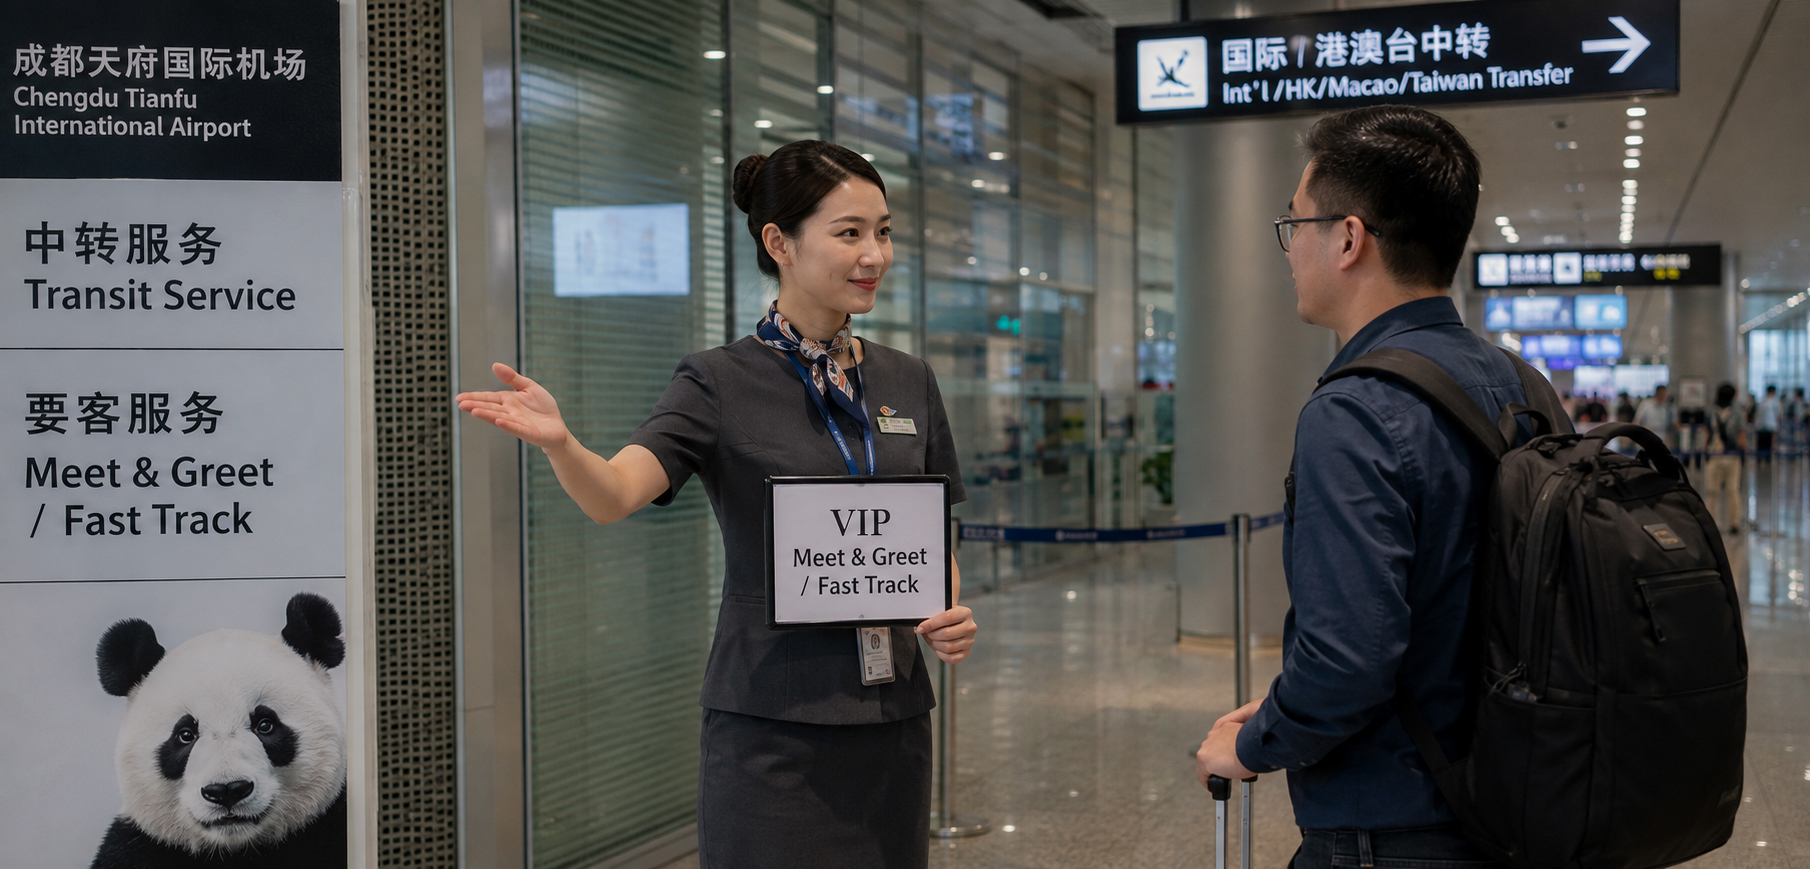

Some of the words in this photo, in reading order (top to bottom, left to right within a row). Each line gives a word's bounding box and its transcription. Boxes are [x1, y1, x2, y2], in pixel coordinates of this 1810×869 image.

[1314, 22, 1490, 67] 港澳台中转
[12, 43, 305, 80] 成都天府国际机场
[1486, 63, 1573, 88] Transfer
[13, 86, 118, 112] Chengdu
[124, 88, 196, 108] Tianfu
[15, 115, 163, 136] International
[169, 117, 251, 141] Airport
[25, 221, 221, 265] 中转服务
[23, 279, 152, 310] Transit
[163, 280, 295, 310] Service
[24, 391, 223, 434] 要客服务
[25, 457, 120, 488] Meet
[132, 457, 159, 487] &
[171, 457, 273, 487] Greet
[29, 504, 45, 538] /
[65, 505, 141, 535] Fast
[151, 502, 253, 534] Track
[829, 509, 890, 536] VIP
[793, 549, 845, 567] Meet
[851, 548, 865, 566] &
[872, 548, 927, 565] Greet
[800, 576, 809, 596] /
[818, 577, 859, 594] Fast
[864, 574, 919, 593] Track
